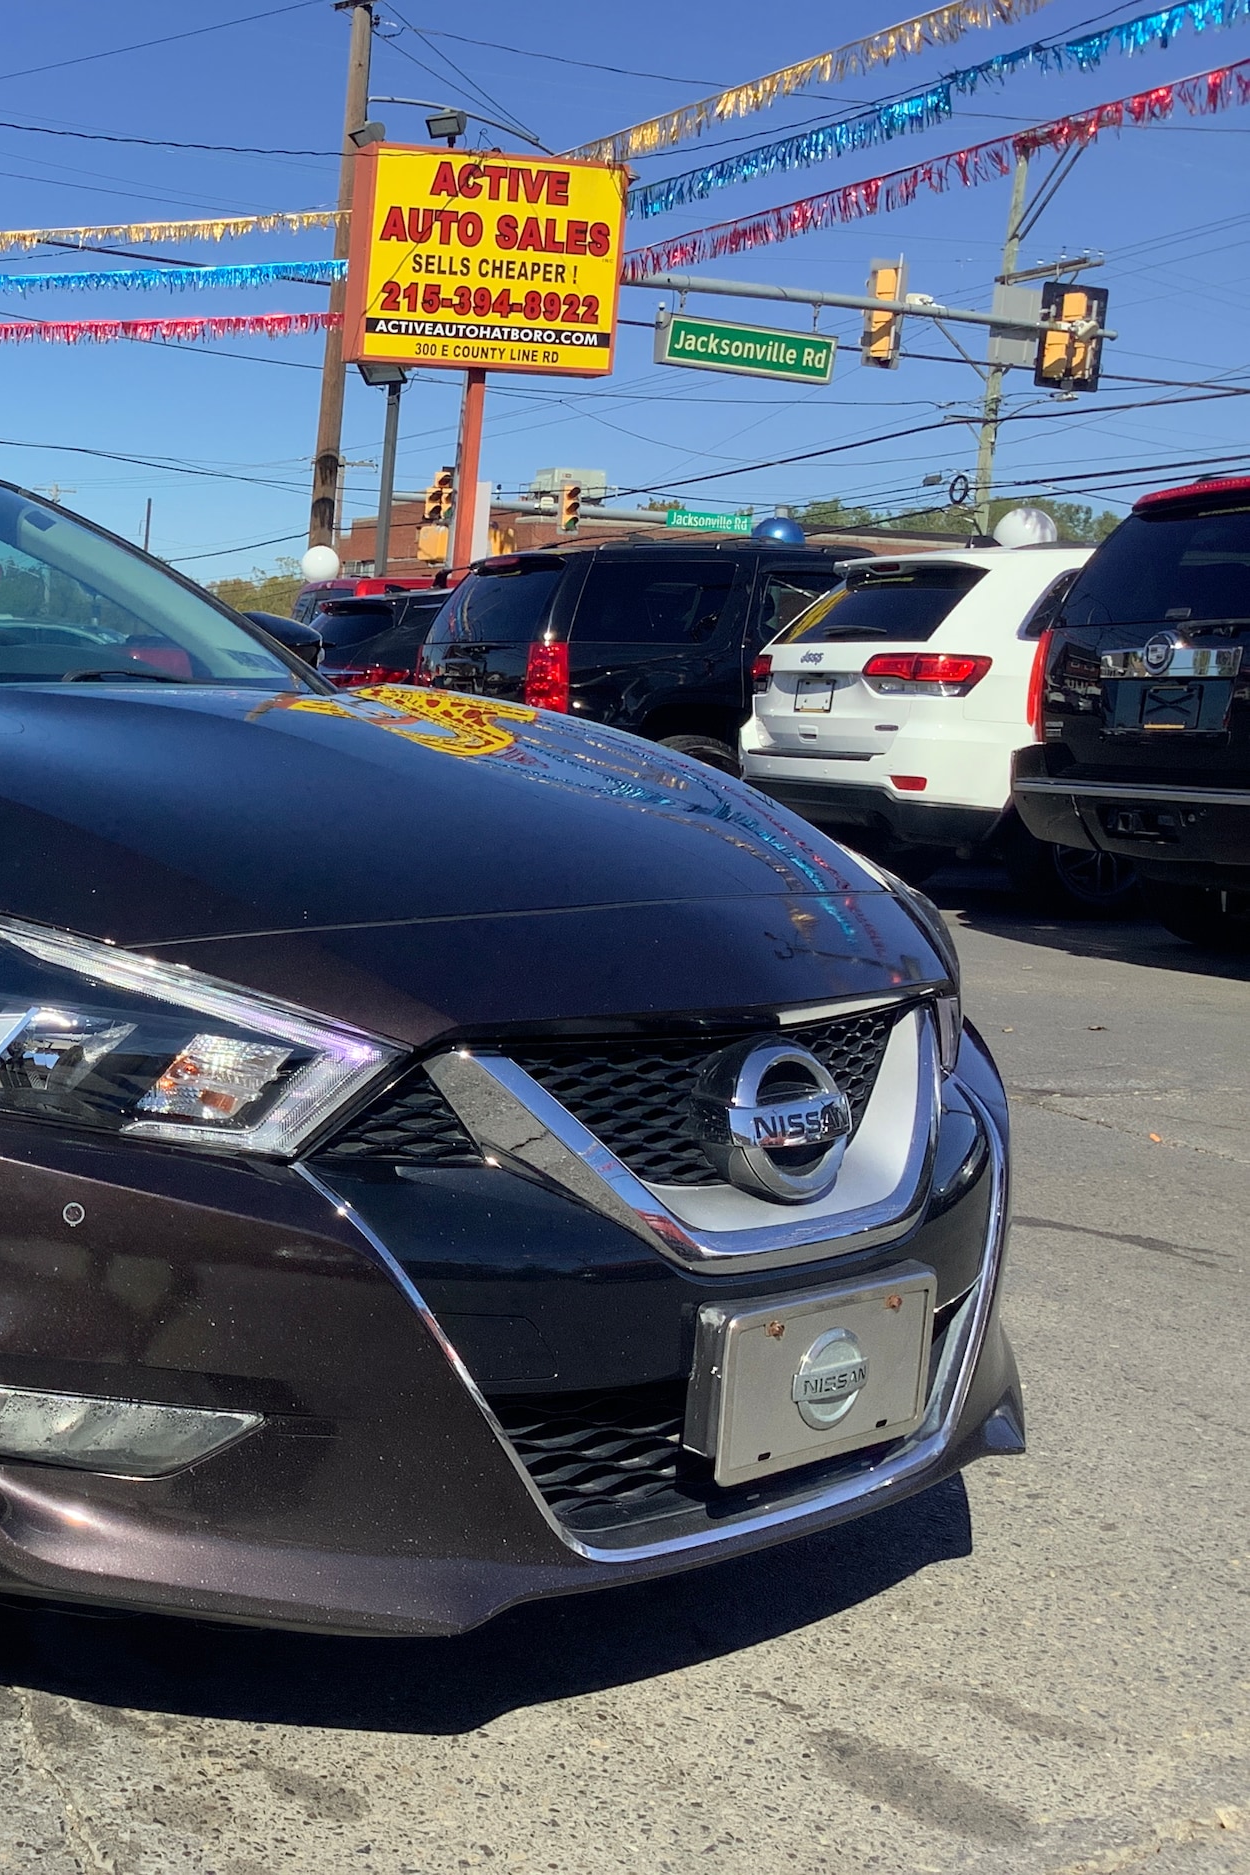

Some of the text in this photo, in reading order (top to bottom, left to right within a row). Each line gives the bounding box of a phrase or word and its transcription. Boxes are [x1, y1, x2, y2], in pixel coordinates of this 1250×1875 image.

[430, 161, 570, 206] ACTIVE
[379, 206, 610, 257] AUTO SALES
[412, 254, 470, 277] SELLS
[478, 259, 566, 283] CHEAPER
[380, 281, 599, 324] 215-394-8922
[375, 320, 598, 346] ACTIVEAUTOHATBORO.COM
[674, 330, 826, 369] Jacksonville Rd
[415, 342, 559, 363] 300 E COUNTY LINE RD
[671, 512, 747, 531] Jacksonville Rd
[753, 1102, 847, 1139] NISSAN
[803, 1365, 867, 1395] NISSAN
